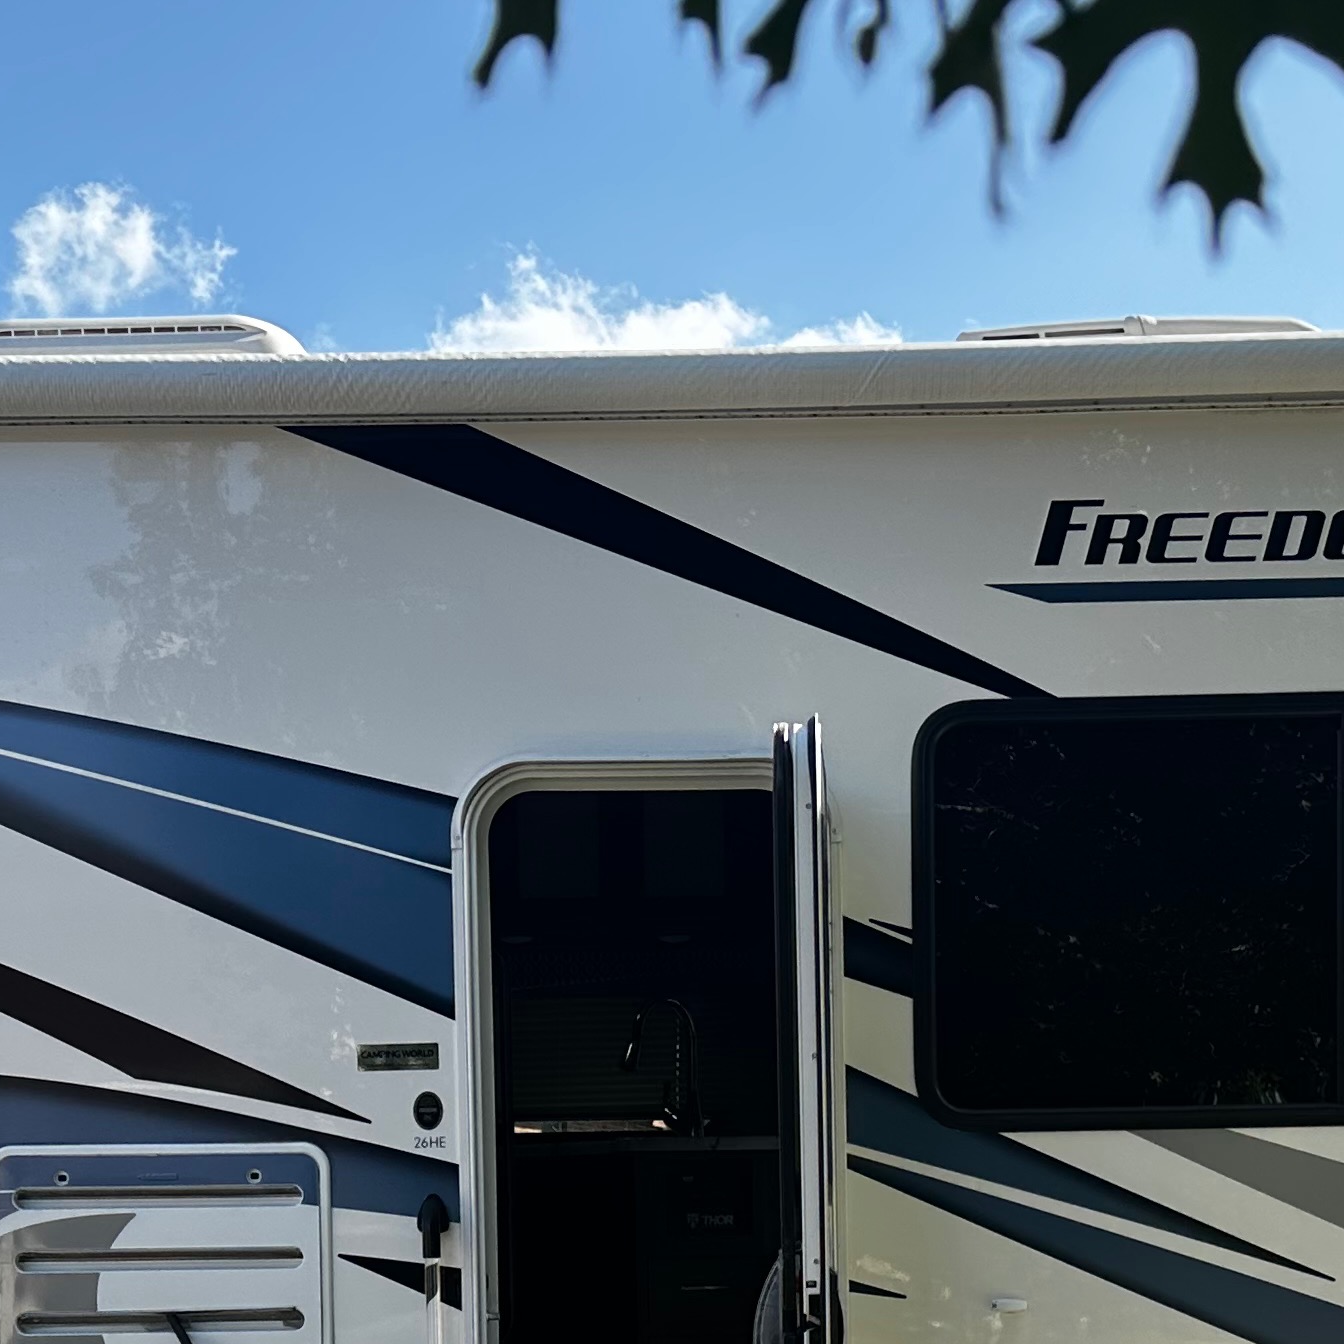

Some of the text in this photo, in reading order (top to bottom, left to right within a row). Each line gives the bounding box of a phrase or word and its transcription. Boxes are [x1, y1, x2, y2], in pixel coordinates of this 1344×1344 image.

[401, 1048, 434, 1058] WORLD
[413, 1136, 447, 1149] 26HE
[701, 1214, 734, 1225] THOR
